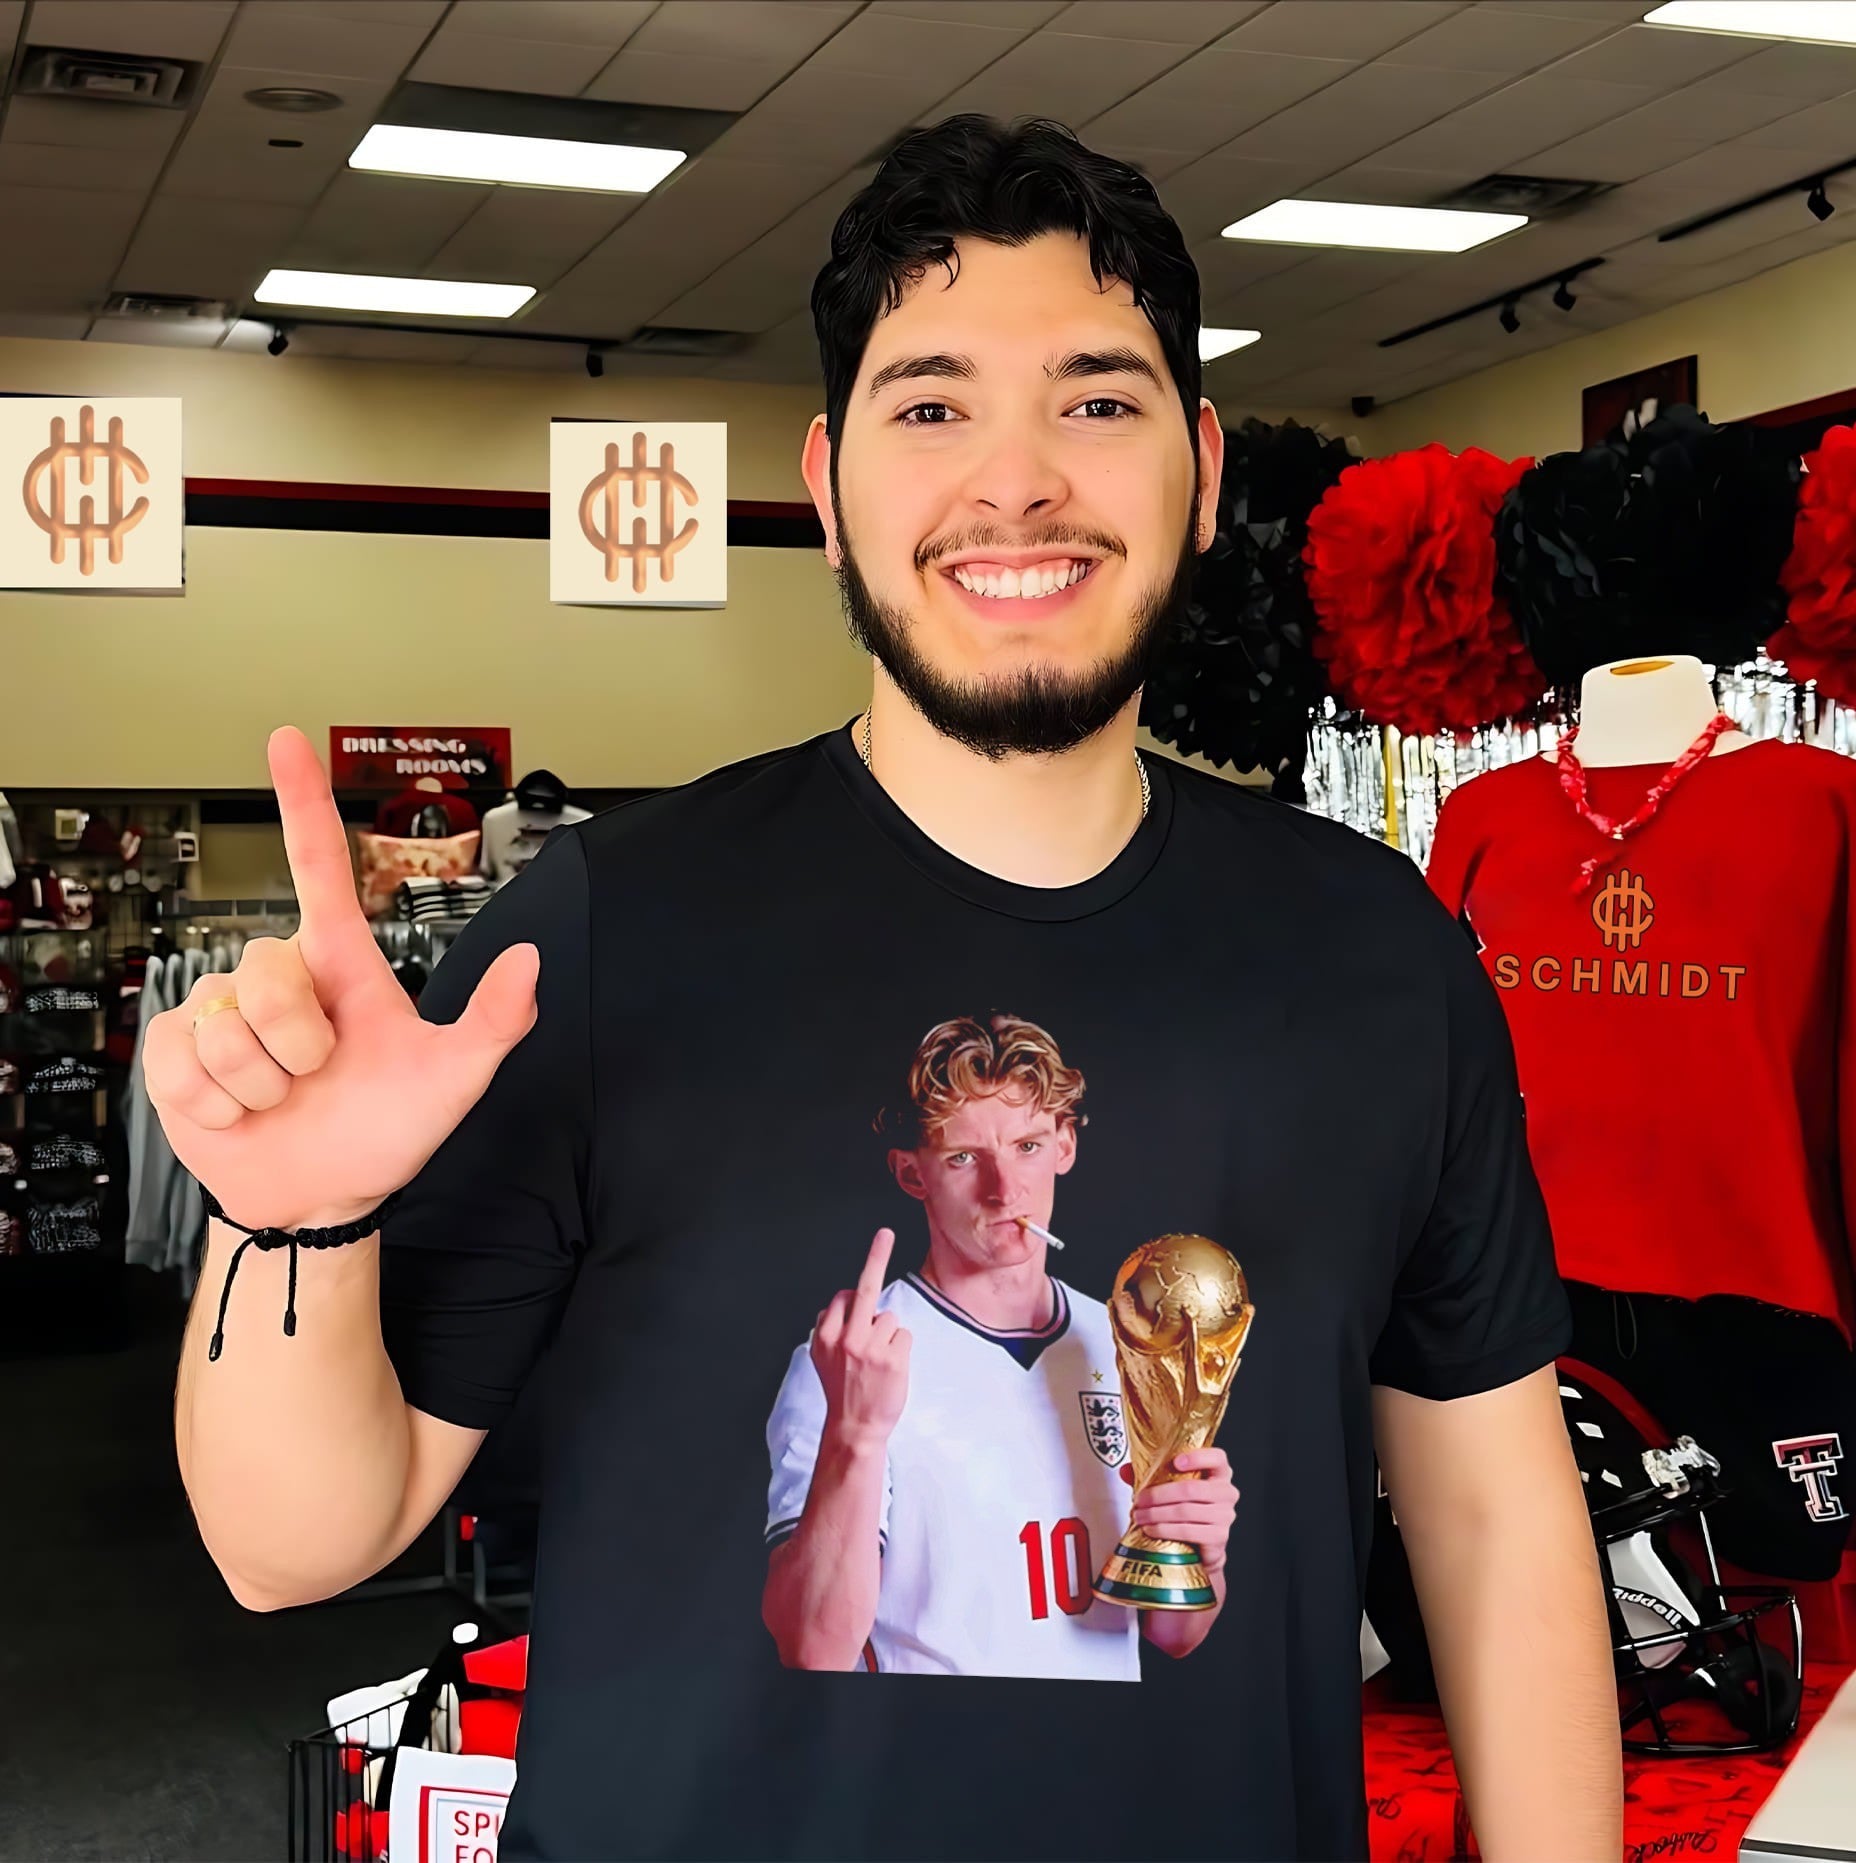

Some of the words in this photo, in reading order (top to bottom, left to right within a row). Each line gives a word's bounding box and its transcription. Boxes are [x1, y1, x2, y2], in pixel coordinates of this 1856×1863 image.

[1494, 953, 1747, 1000] SCHMIDT
[1018, 1516, 1094, 1621] 10
[1121, 1560, 1163, 1578] FIFA
